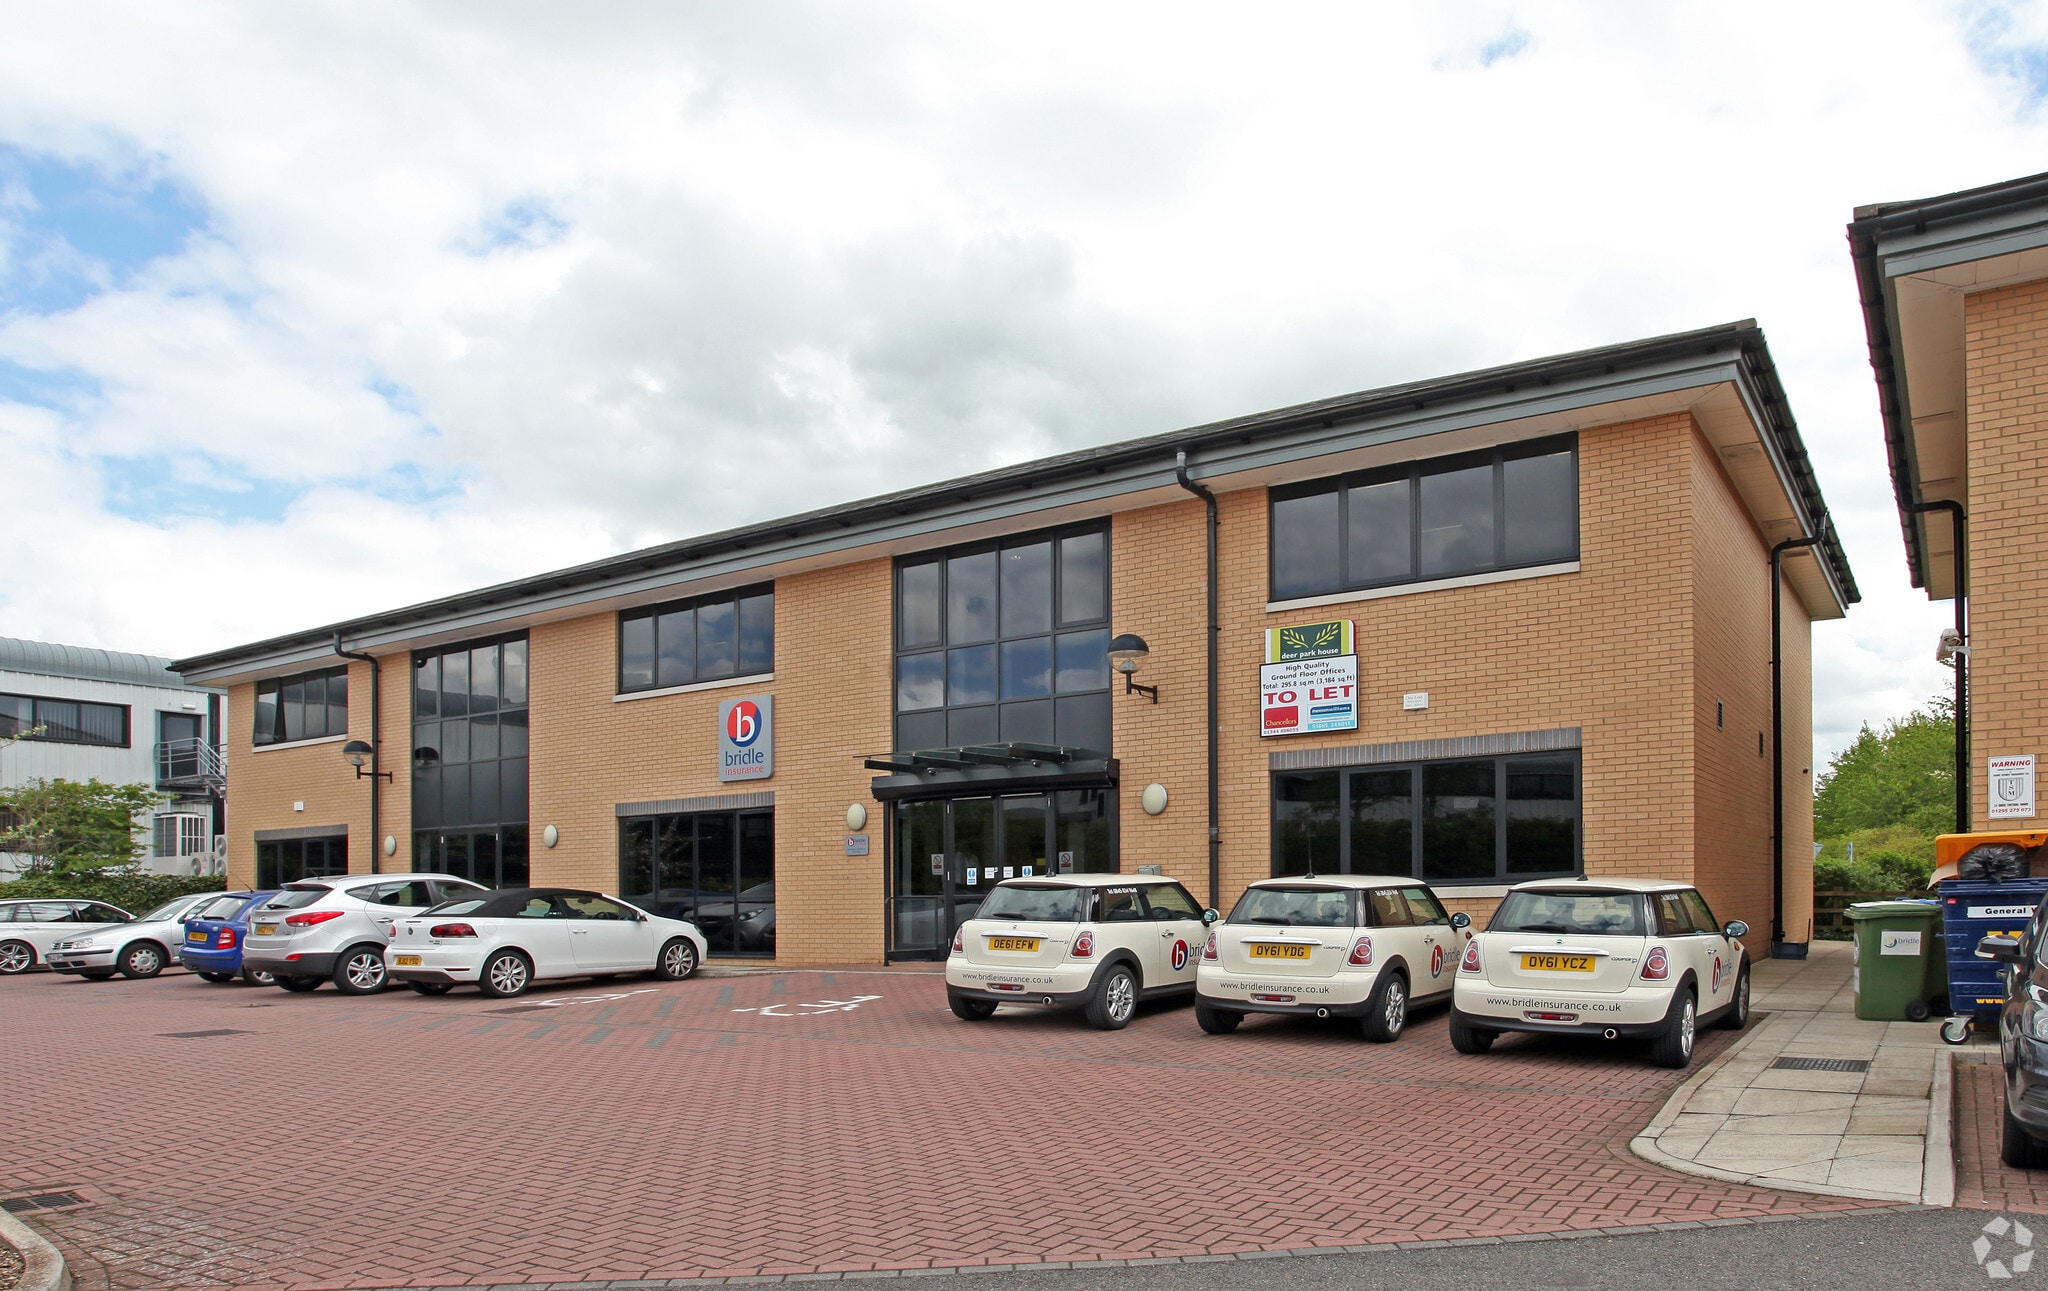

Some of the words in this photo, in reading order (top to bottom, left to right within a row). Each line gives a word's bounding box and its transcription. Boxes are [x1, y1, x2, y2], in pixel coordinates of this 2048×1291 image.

[1299, 649, 1316, 659] park
[1317, 648, 1339, 656] house
[1285, 664, 1302, 672] High
[1303, 662, 1330, 670] Quality
[1271, 672, 1297, 681] Ground
[1320, 668, 1346, 676] Offices
[1281, 680, 1297, 688] 295.8
[1263, 690, 1297, 705] TO
[1309, 684, 1354, 701] LET
[736, 706, 756, 742] b
[1265, 718, 1297, 727] Chancellors
[725, 748, 764, 767] bridle
[1991, 760, 2031, 768] WARNING
[725, 765, 764, 776] insurance
[1985, 907, 2026, 915] General
[993, 938, 1014, 949] OE61
[1014, 939, 1034, 950] EFW
[1175, 944, 1185, 968] b
[1189, 943, 1205, 958] brid
[1256, 945, 1281, 956] OY61
[1282, 945, 1305, 957] YDG
[1443, 946, 1460, 963] bridle
[1528, 956, 1558, 968] OY61
[1561, 957, 1587, 969] YCZ
[962, 972, 1054, 985] www.bridleinsurance.co.uk
[1220, 981, 1330, 995] www.bridleinsurance.co.uk
[1486, 996, 1622, 1012] www.bridleinsurance.co.uk
